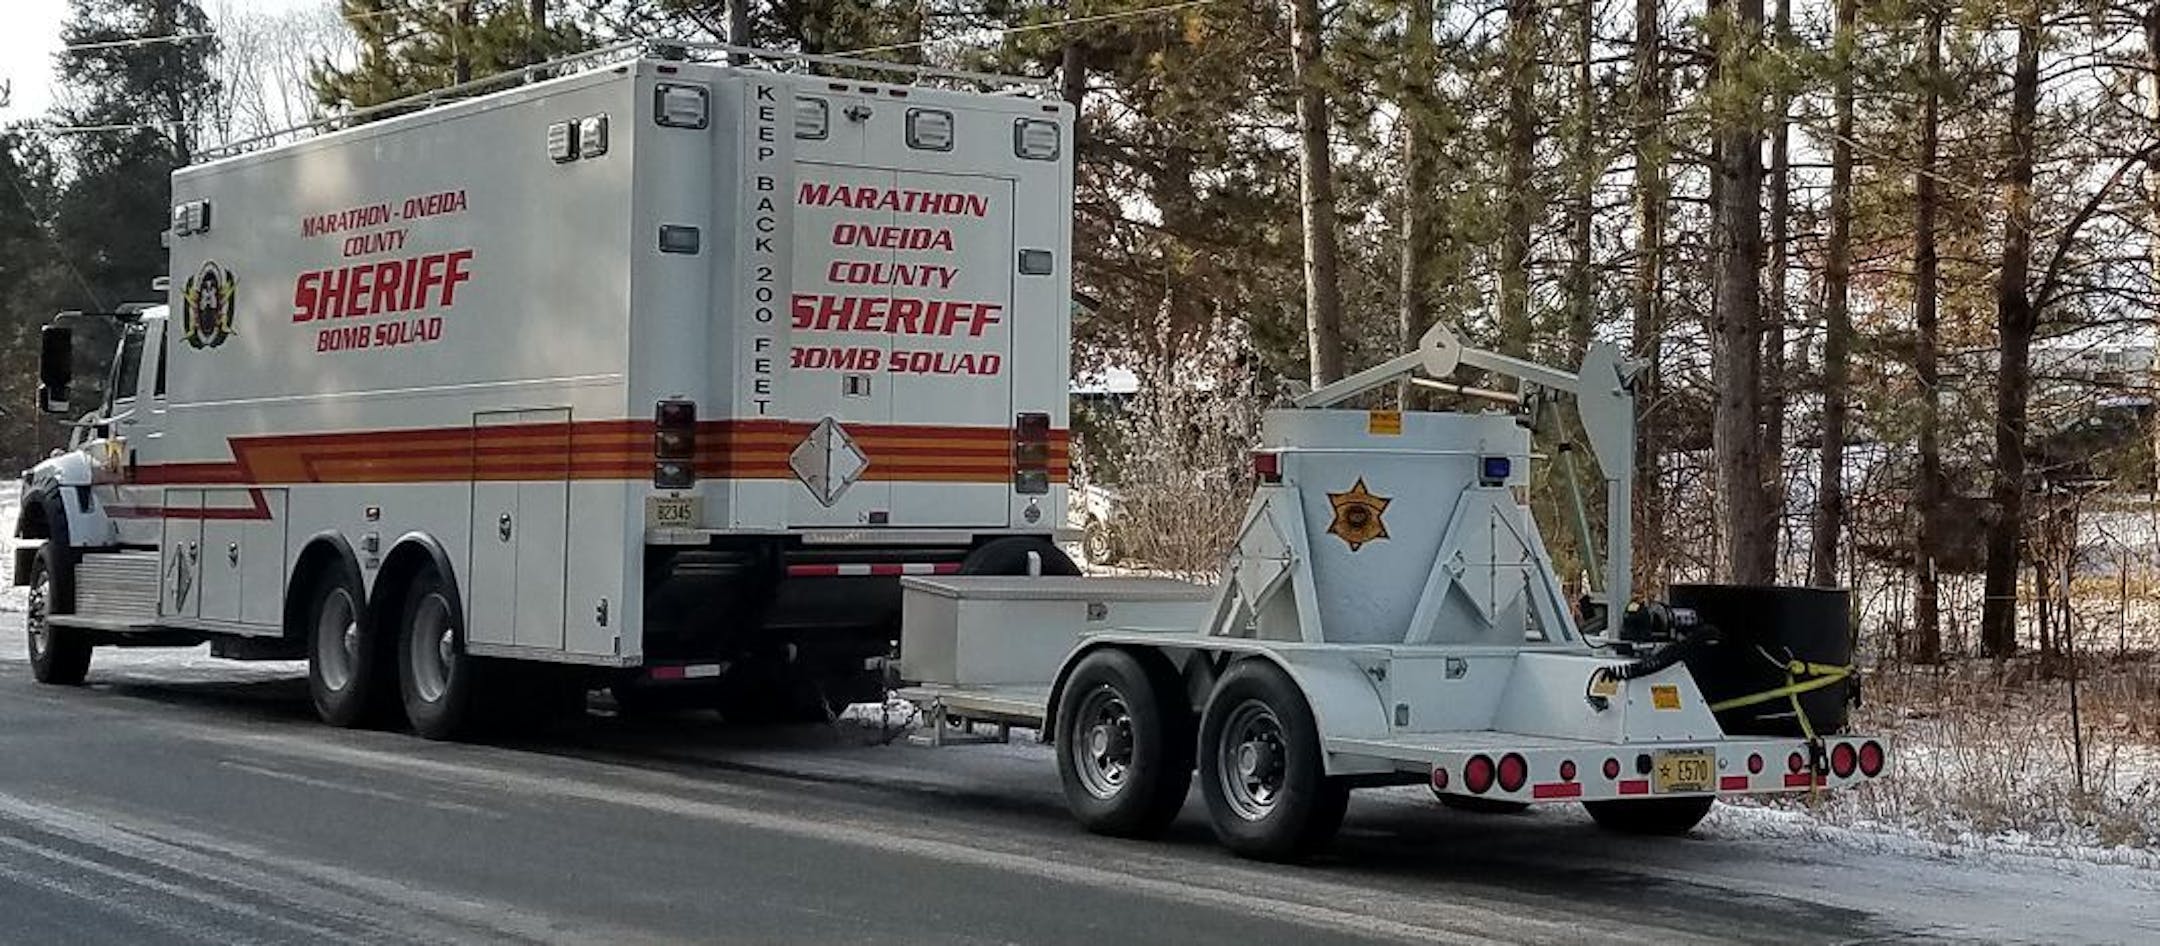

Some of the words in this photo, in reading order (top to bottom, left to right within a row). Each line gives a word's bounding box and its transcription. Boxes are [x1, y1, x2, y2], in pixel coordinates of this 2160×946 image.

[757, 85, 776, 161] KEEP
[301, 203, 392, 238] MARATHON
[403, 190, 468, 220] ONEIDA
[755, 176, 775, 253] BACK
[798, 182, 988, 217] MARATHON
[343, 229, 408, 257] COUNTY
[832, 224, 954, 251] ONEIDA
[292, 249, 474, 323] SHERIFF
[756, 267, 773, 323] 200
[828, 261, 959, 289] COUNTY
[317, 326, 370, 352] BOMB
[374, 317, 442, 347] SQUAD
[791, 293, 1003, 337] SHERIFF
[754, 338, 772, 415] FEET
[887, 352, 1000, 376] SQUAD
